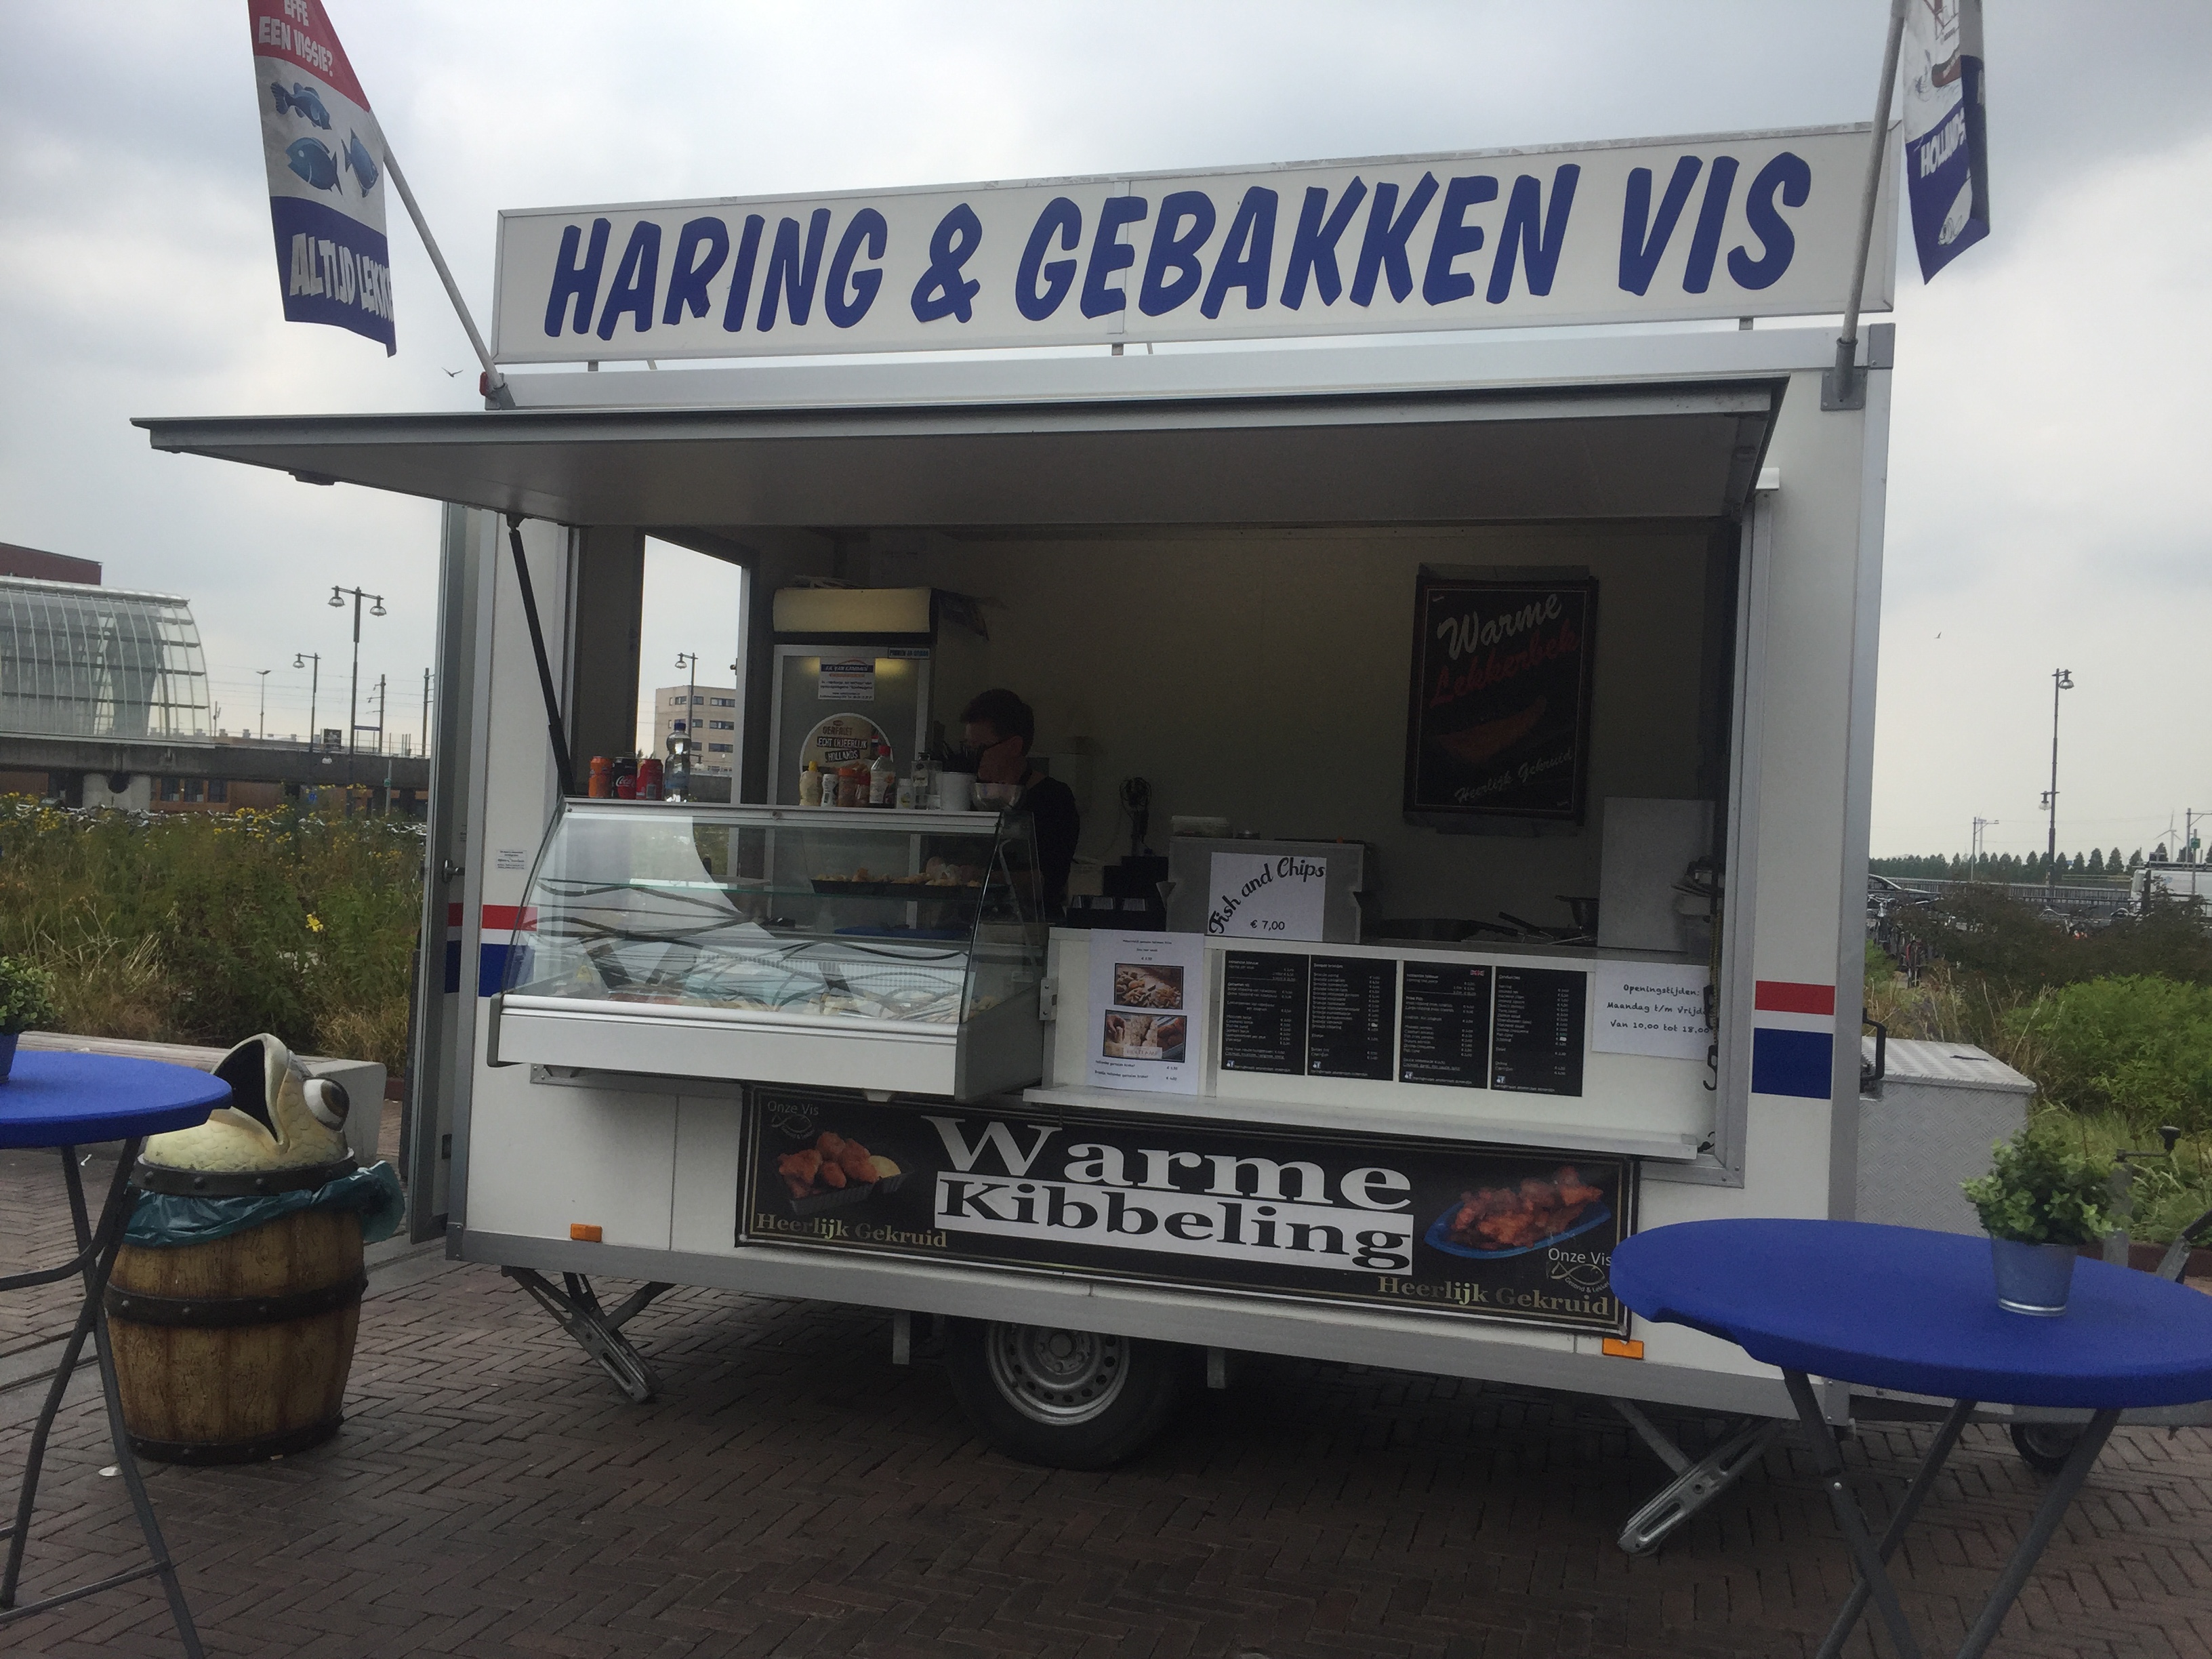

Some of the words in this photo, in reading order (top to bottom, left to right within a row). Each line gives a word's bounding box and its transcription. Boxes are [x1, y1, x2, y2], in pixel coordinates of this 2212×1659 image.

[284, 0, 309, 26] EFFE
[259, 16, 291, 51] EEN
[293, 29, 333, 77] VISSIE?
[544, 207, 888, 340] HARING
[910, 203, 983, 323] &
[1015, 164, 1580, 321] GEBAKKEN
[1618, 151, 1811, 296] VIS
[289, 232, 356, 305] ALTIJD
[356, 253, 394, 323] LEKKE
[1436, 593, 1563, 660] Warme
[818, 737, 833, 747] ECHT
[827, 750, 859, 761] HOLLANDS
[1208, 895, 1241, 934] Fish
[1241, 863, 1273, 897] and
[1277, 857, 1326, 882] Chips
[1250, 919, 1258, 928] €
[1262, 920, 1286, 931] 7,00
[1623, 983, 1700, 997] Openingstijden:
[1607, 1002, 1650, 1013] Maandag
[1654, 1004, 1673, 1012] t/m
[1677, 1006, 1706, 1017] Vrijd
[1610, 1019, 1629, 1028] Van
[1663, 1023, 1678, 1031] tot
[767, 1100, 798, 1114] Onze
[801, 1103, 819, 1116] Vis
[921, 1115, 1412, 1211] Warme
[756, 1212, 849, 1240] Heerlijk
[855, 1222, 947, 1248] Gekruid
[937, 1179, 1411, 1271] Kibbeling
[1548, 1248, 1586, 1264] Onze
[1590, 1251, 1612, 1267] Vis
[1378, 1275, 1490, 1306] Heerlijk
[1496, 1287, 1610, 1317] Gekruid
